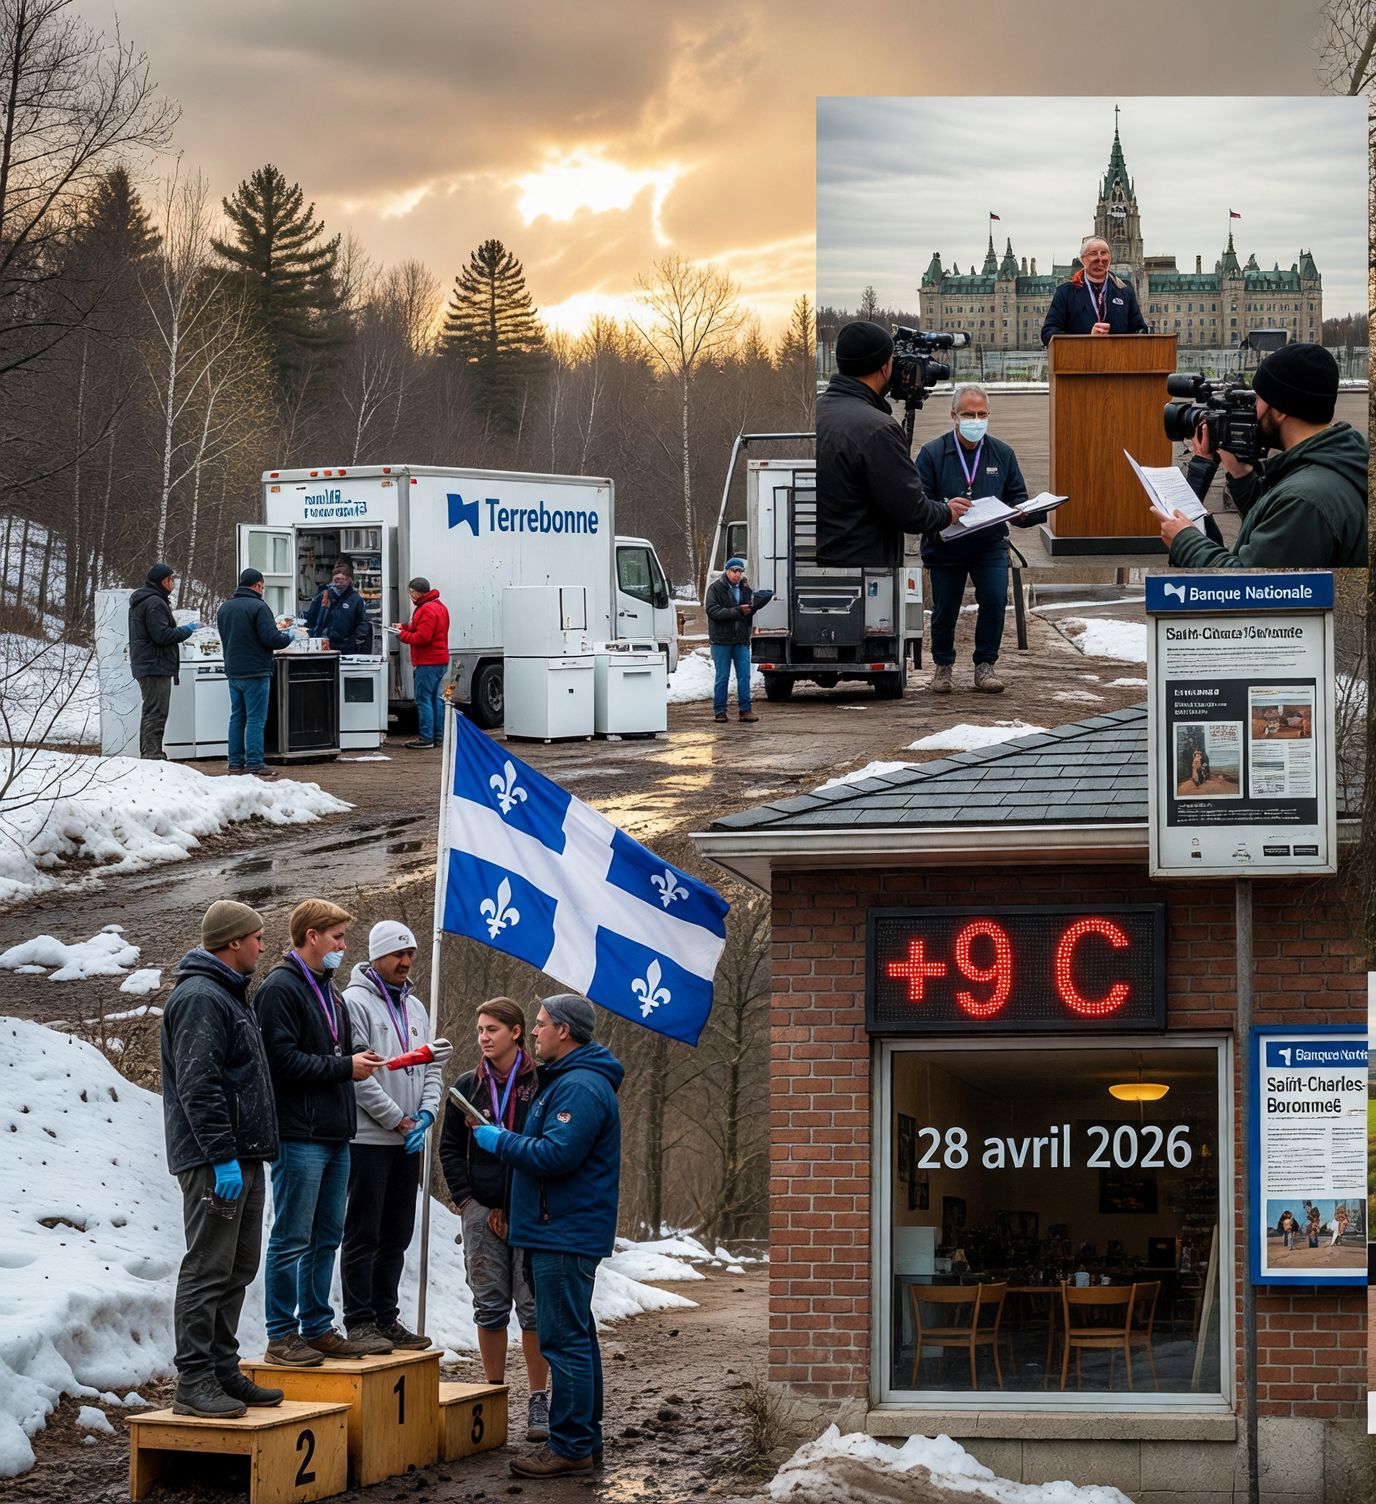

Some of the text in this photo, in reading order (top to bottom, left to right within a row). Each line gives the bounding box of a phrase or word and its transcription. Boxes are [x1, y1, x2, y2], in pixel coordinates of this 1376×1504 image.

[485, 498, 599, 534] Terrebonne
[1190, 585, 1313, 604] Banque Nationale
[1056, 918, 1130, 1016] C
[917, 1124, 1193, 1169] 28 avril 2026
[393, 1375, 406, 1425] 1
[295, 1429, 316, 1488] 2
